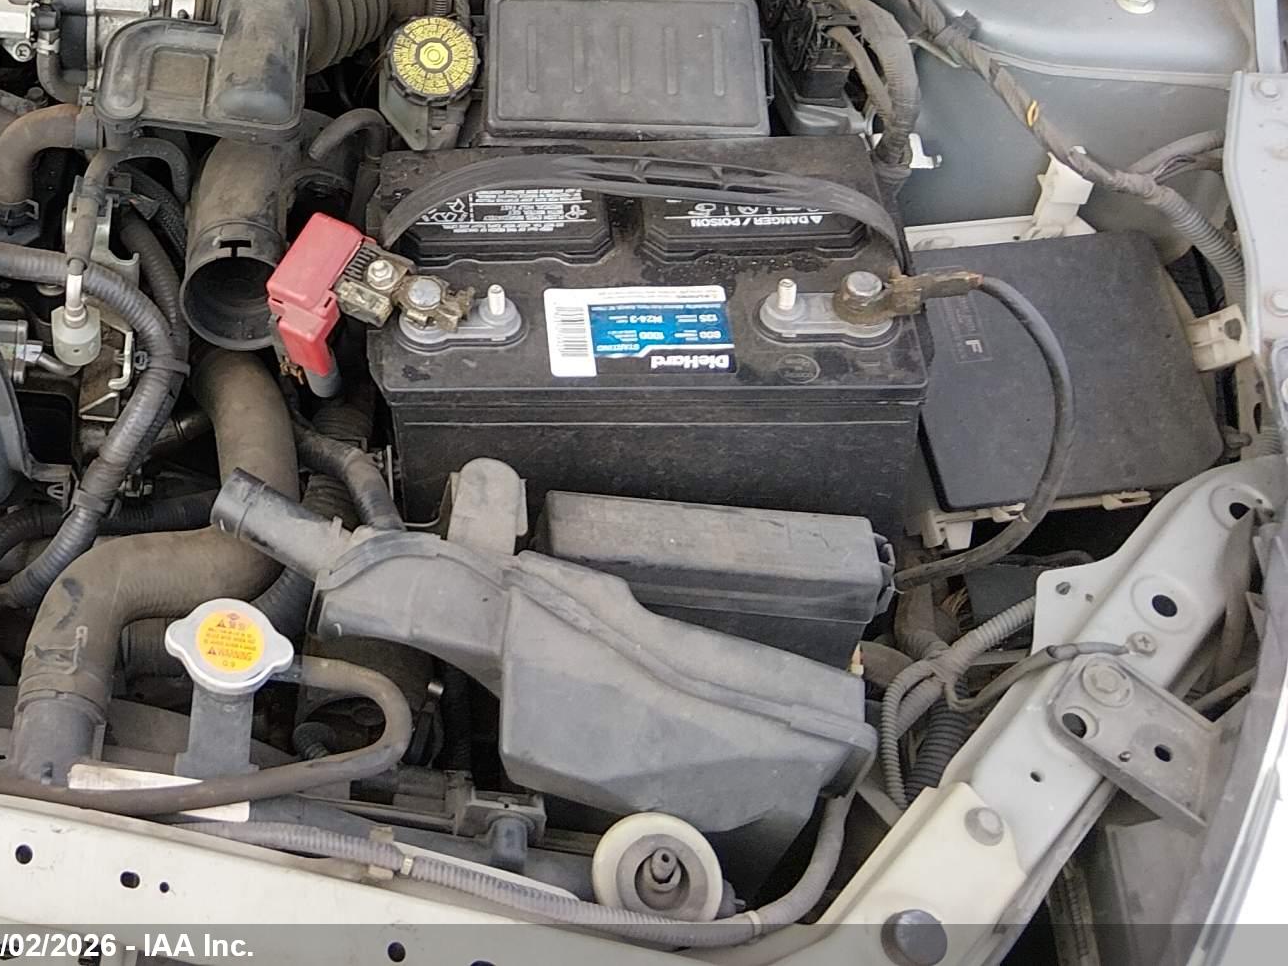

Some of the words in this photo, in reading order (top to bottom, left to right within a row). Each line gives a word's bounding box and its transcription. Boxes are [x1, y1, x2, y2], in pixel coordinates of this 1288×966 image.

[691, 217, 741, 228] POISON
[753, 215, 809, 226] DANGER
[650, 354, 730, 370] DieHard
